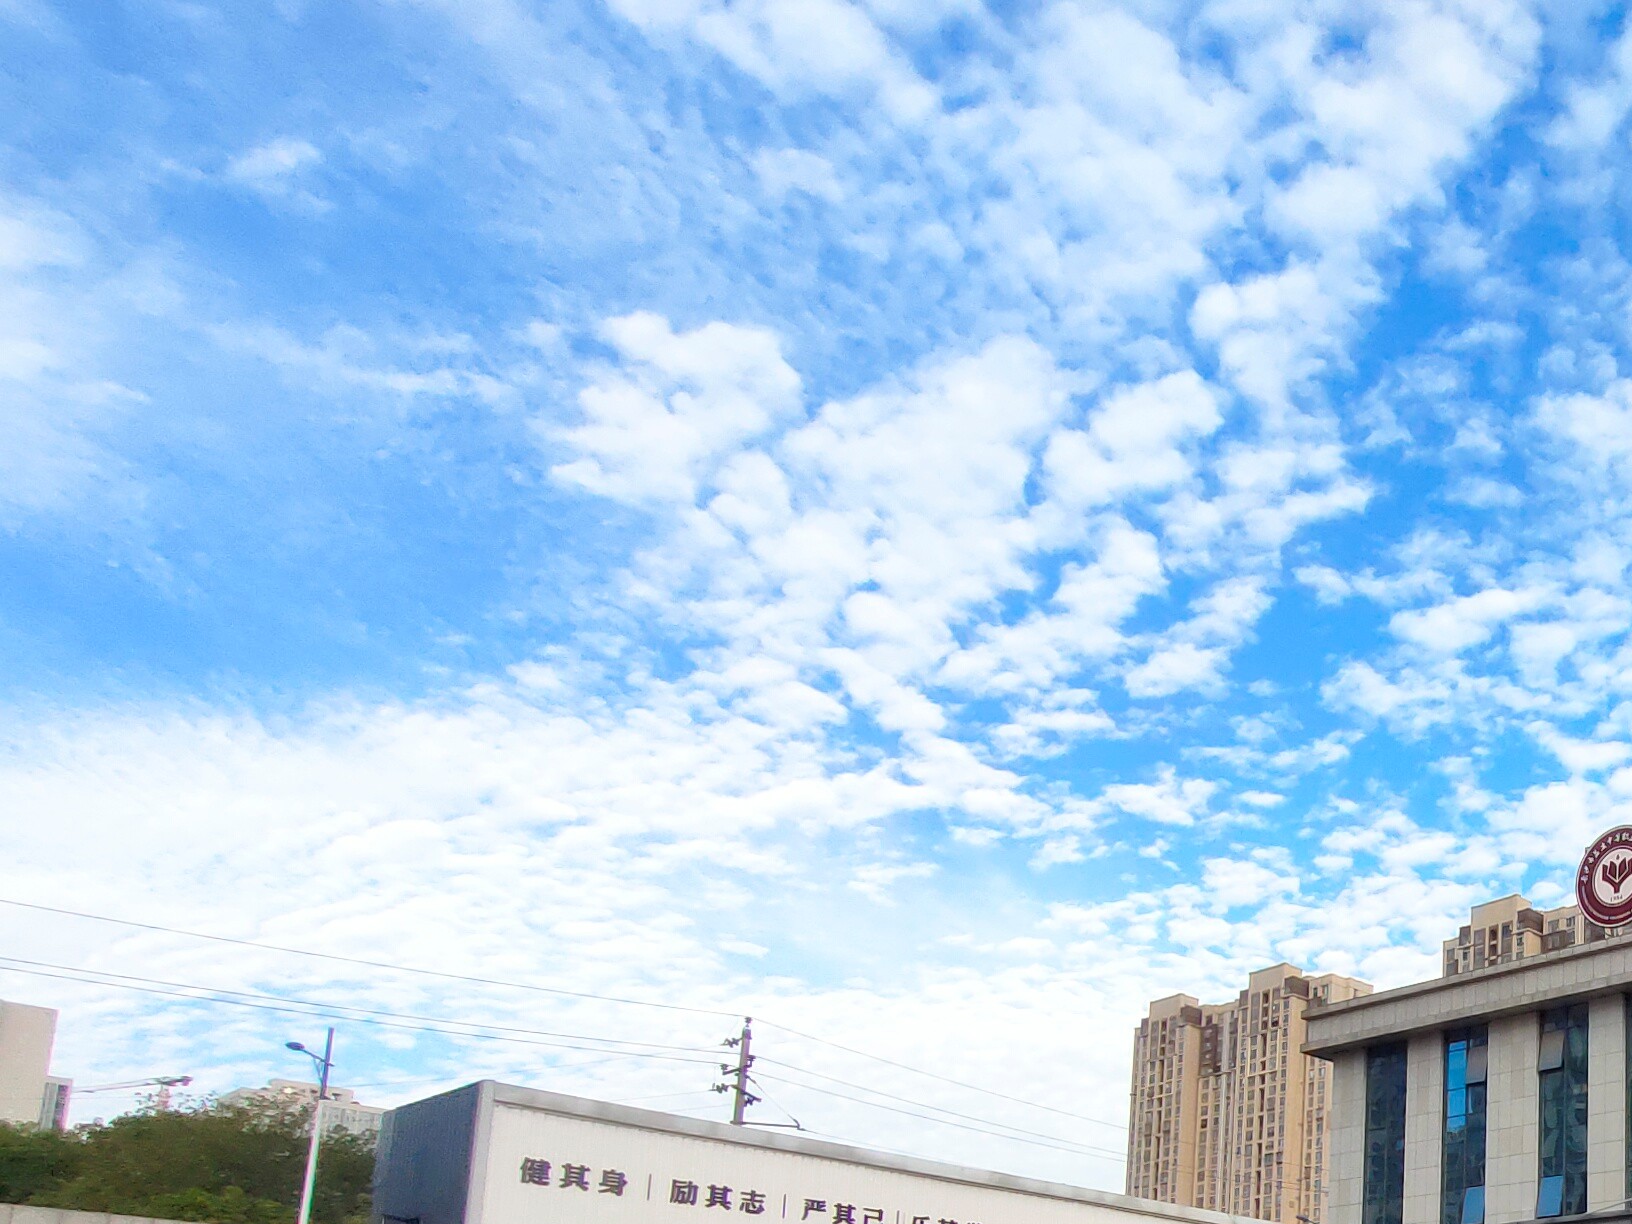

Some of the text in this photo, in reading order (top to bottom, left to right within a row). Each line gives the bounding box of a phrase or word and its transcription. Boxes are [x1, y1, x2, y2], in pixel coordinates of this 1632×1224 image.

[519, 1156, 629, 1196] 健其身
[669, 1178, 767, 1215] 励其志
